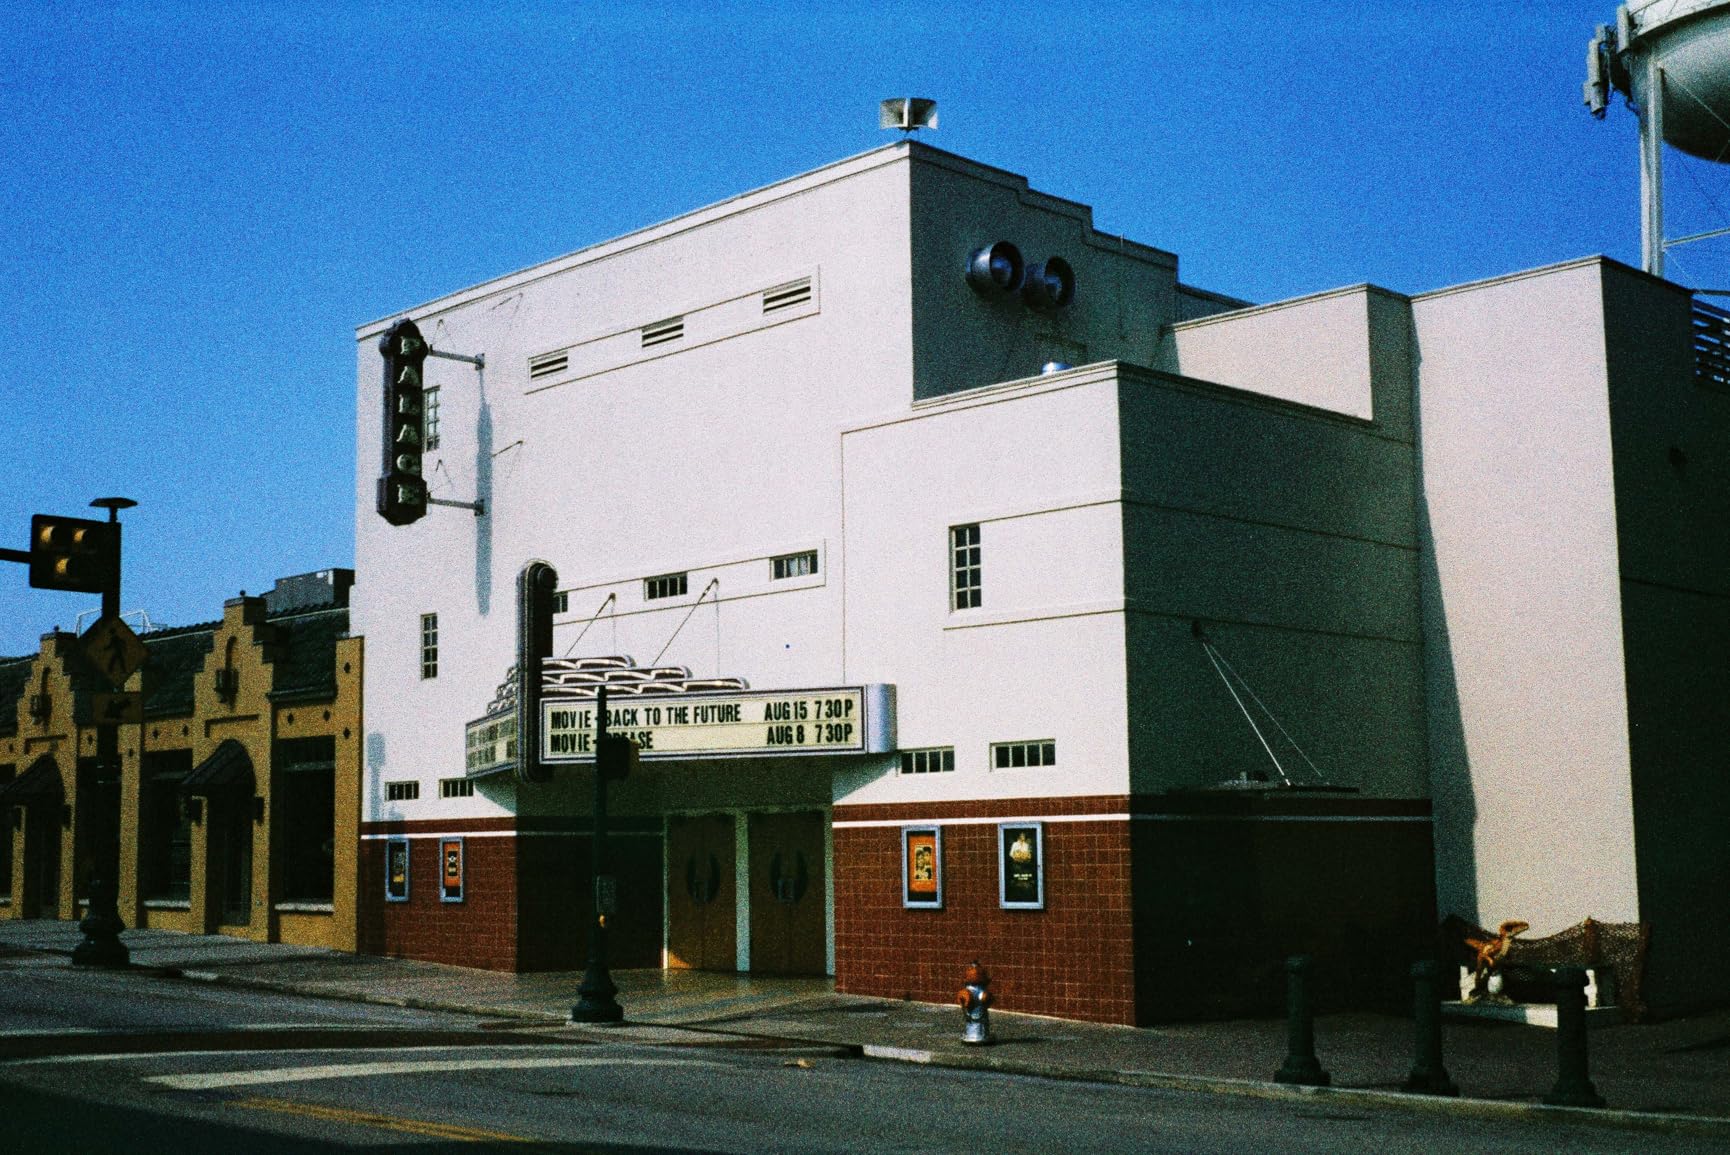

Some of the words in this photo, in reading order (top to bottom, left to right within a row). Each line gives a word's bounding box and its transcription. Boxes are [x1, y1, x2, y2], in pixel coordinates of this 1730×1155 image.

[551, 710, 591, 729] MOVIE
[605, 708, 639, 727] BACK
[644, 707, 660, 726] TO
[666, 706, 689, 725] THE
[693, 703, 741, 724] FUTURE
[550, 733, 590, 753] MOVIE
[767, 725, 793, 745] AUG
[796, 725, 805, 744] 8
